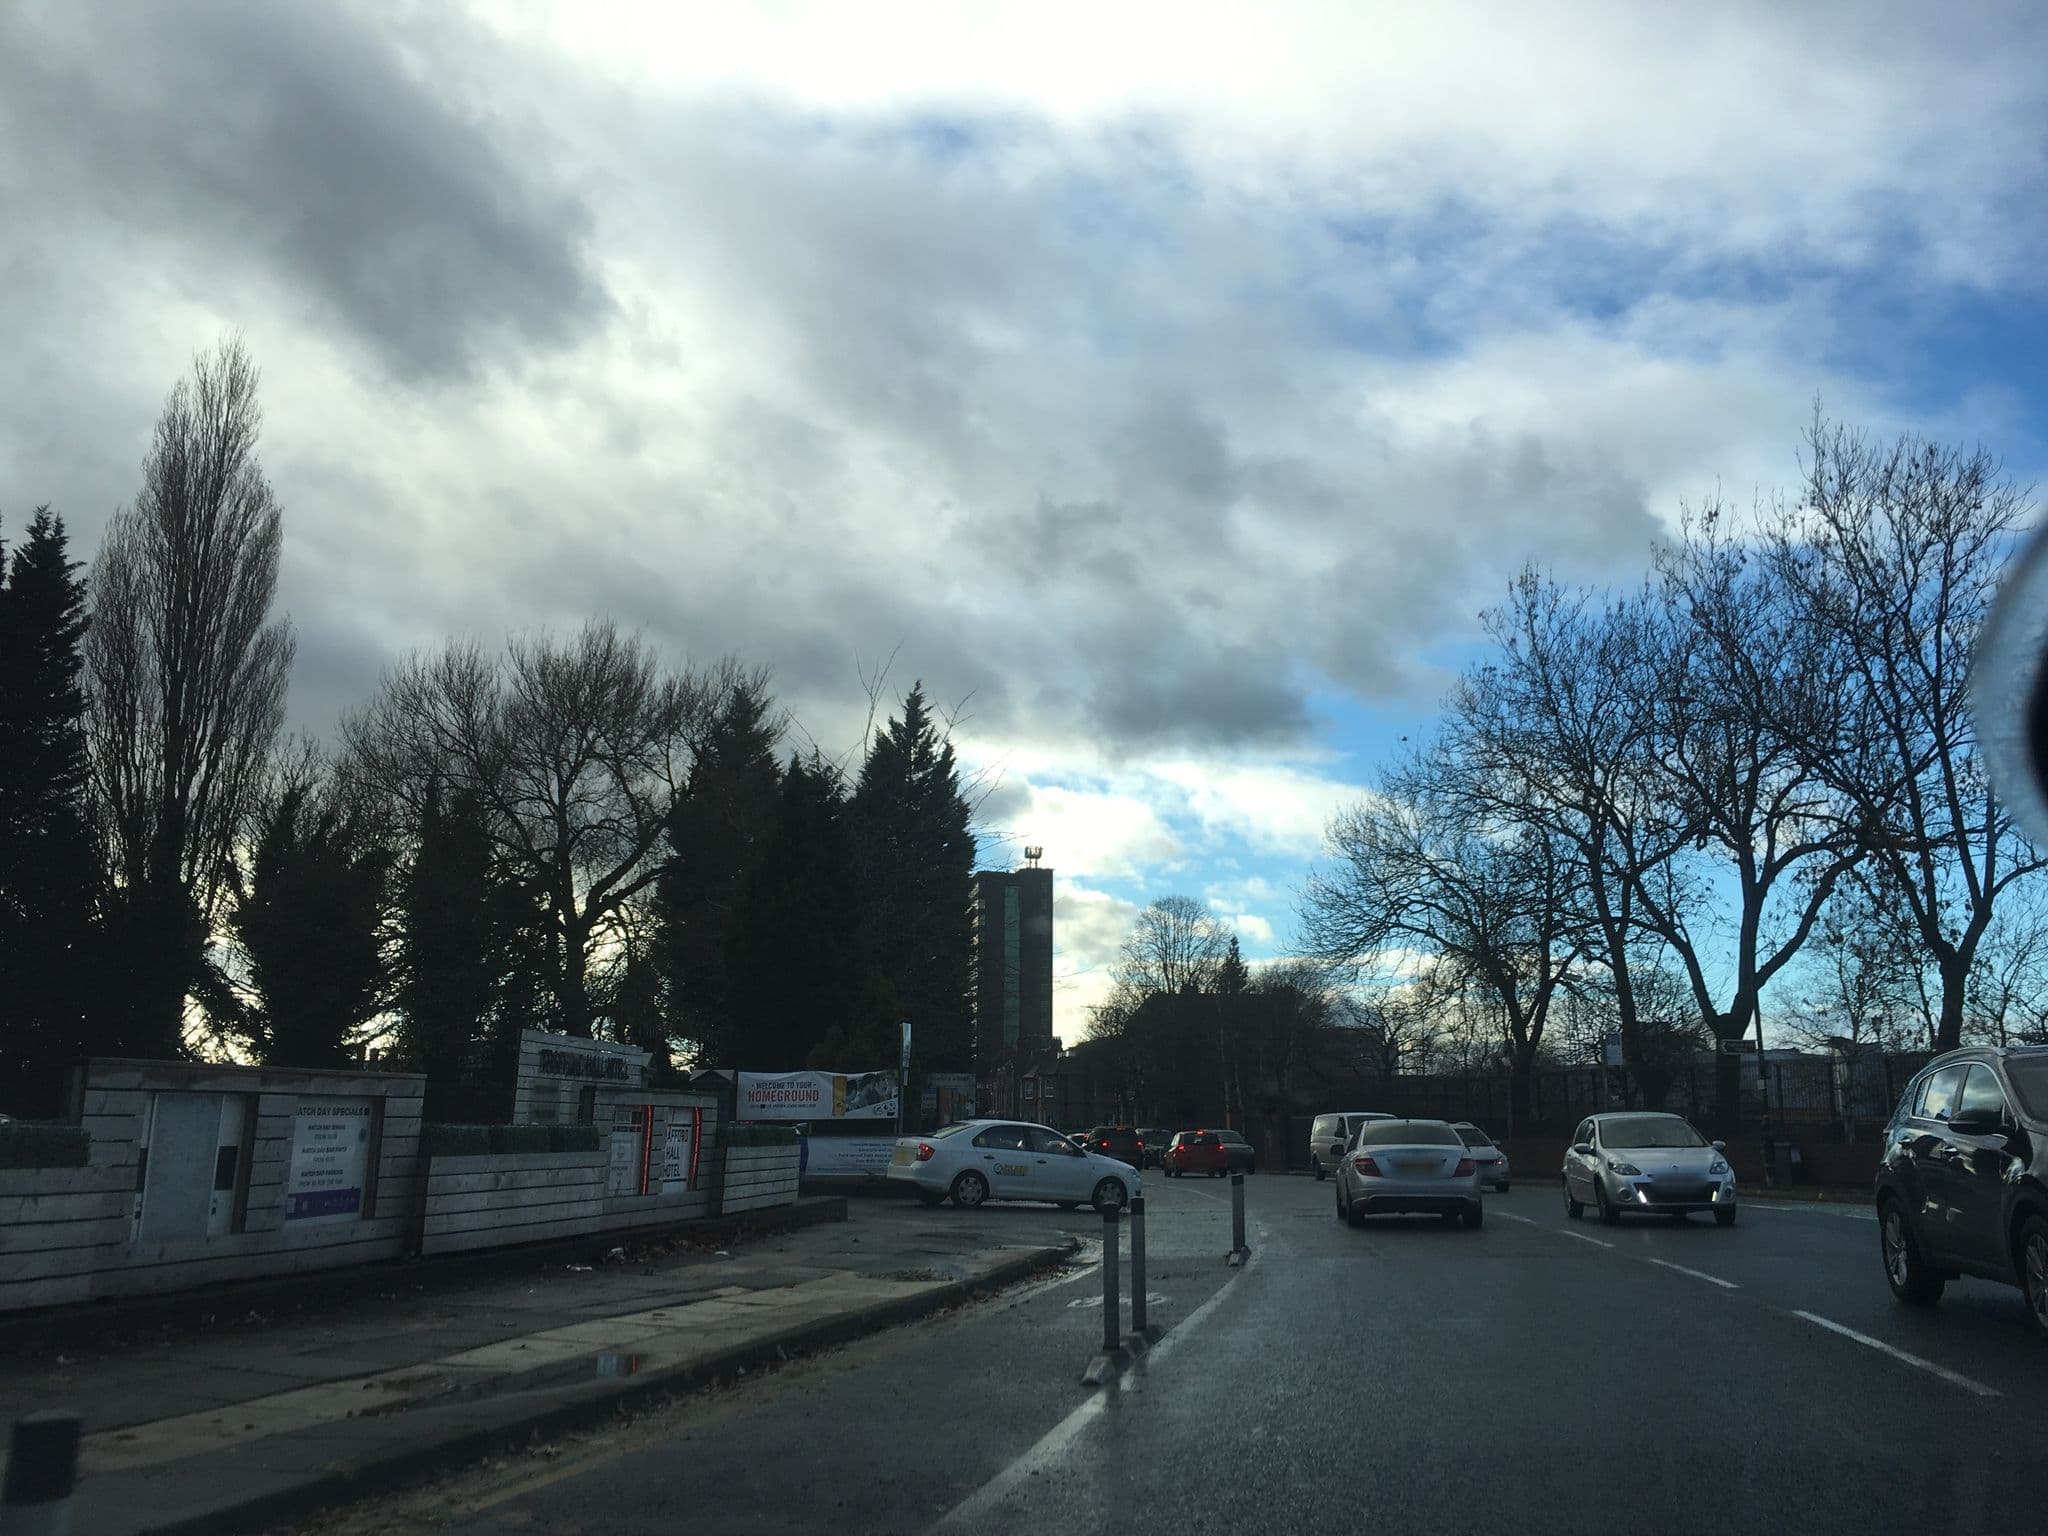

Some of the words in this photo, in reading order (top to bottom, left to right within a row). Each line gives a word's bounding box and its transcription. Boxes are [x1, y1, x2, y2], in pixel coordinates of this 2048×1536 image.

[755, 1082, 785, 1090] WELCOME
[787, 1081, 795, 1089] TO
[796, 1081, 812, 1089] YOUR
[747, 1089, 820, 1102] HOMEGROUND
[317, 1106, 332, 1117] DAY
[332, 1106, 363, 1117] SPECIALS
[665, 1146, 681, 1160] HALL
[663, 1162, 681, 1177] HOTEL
